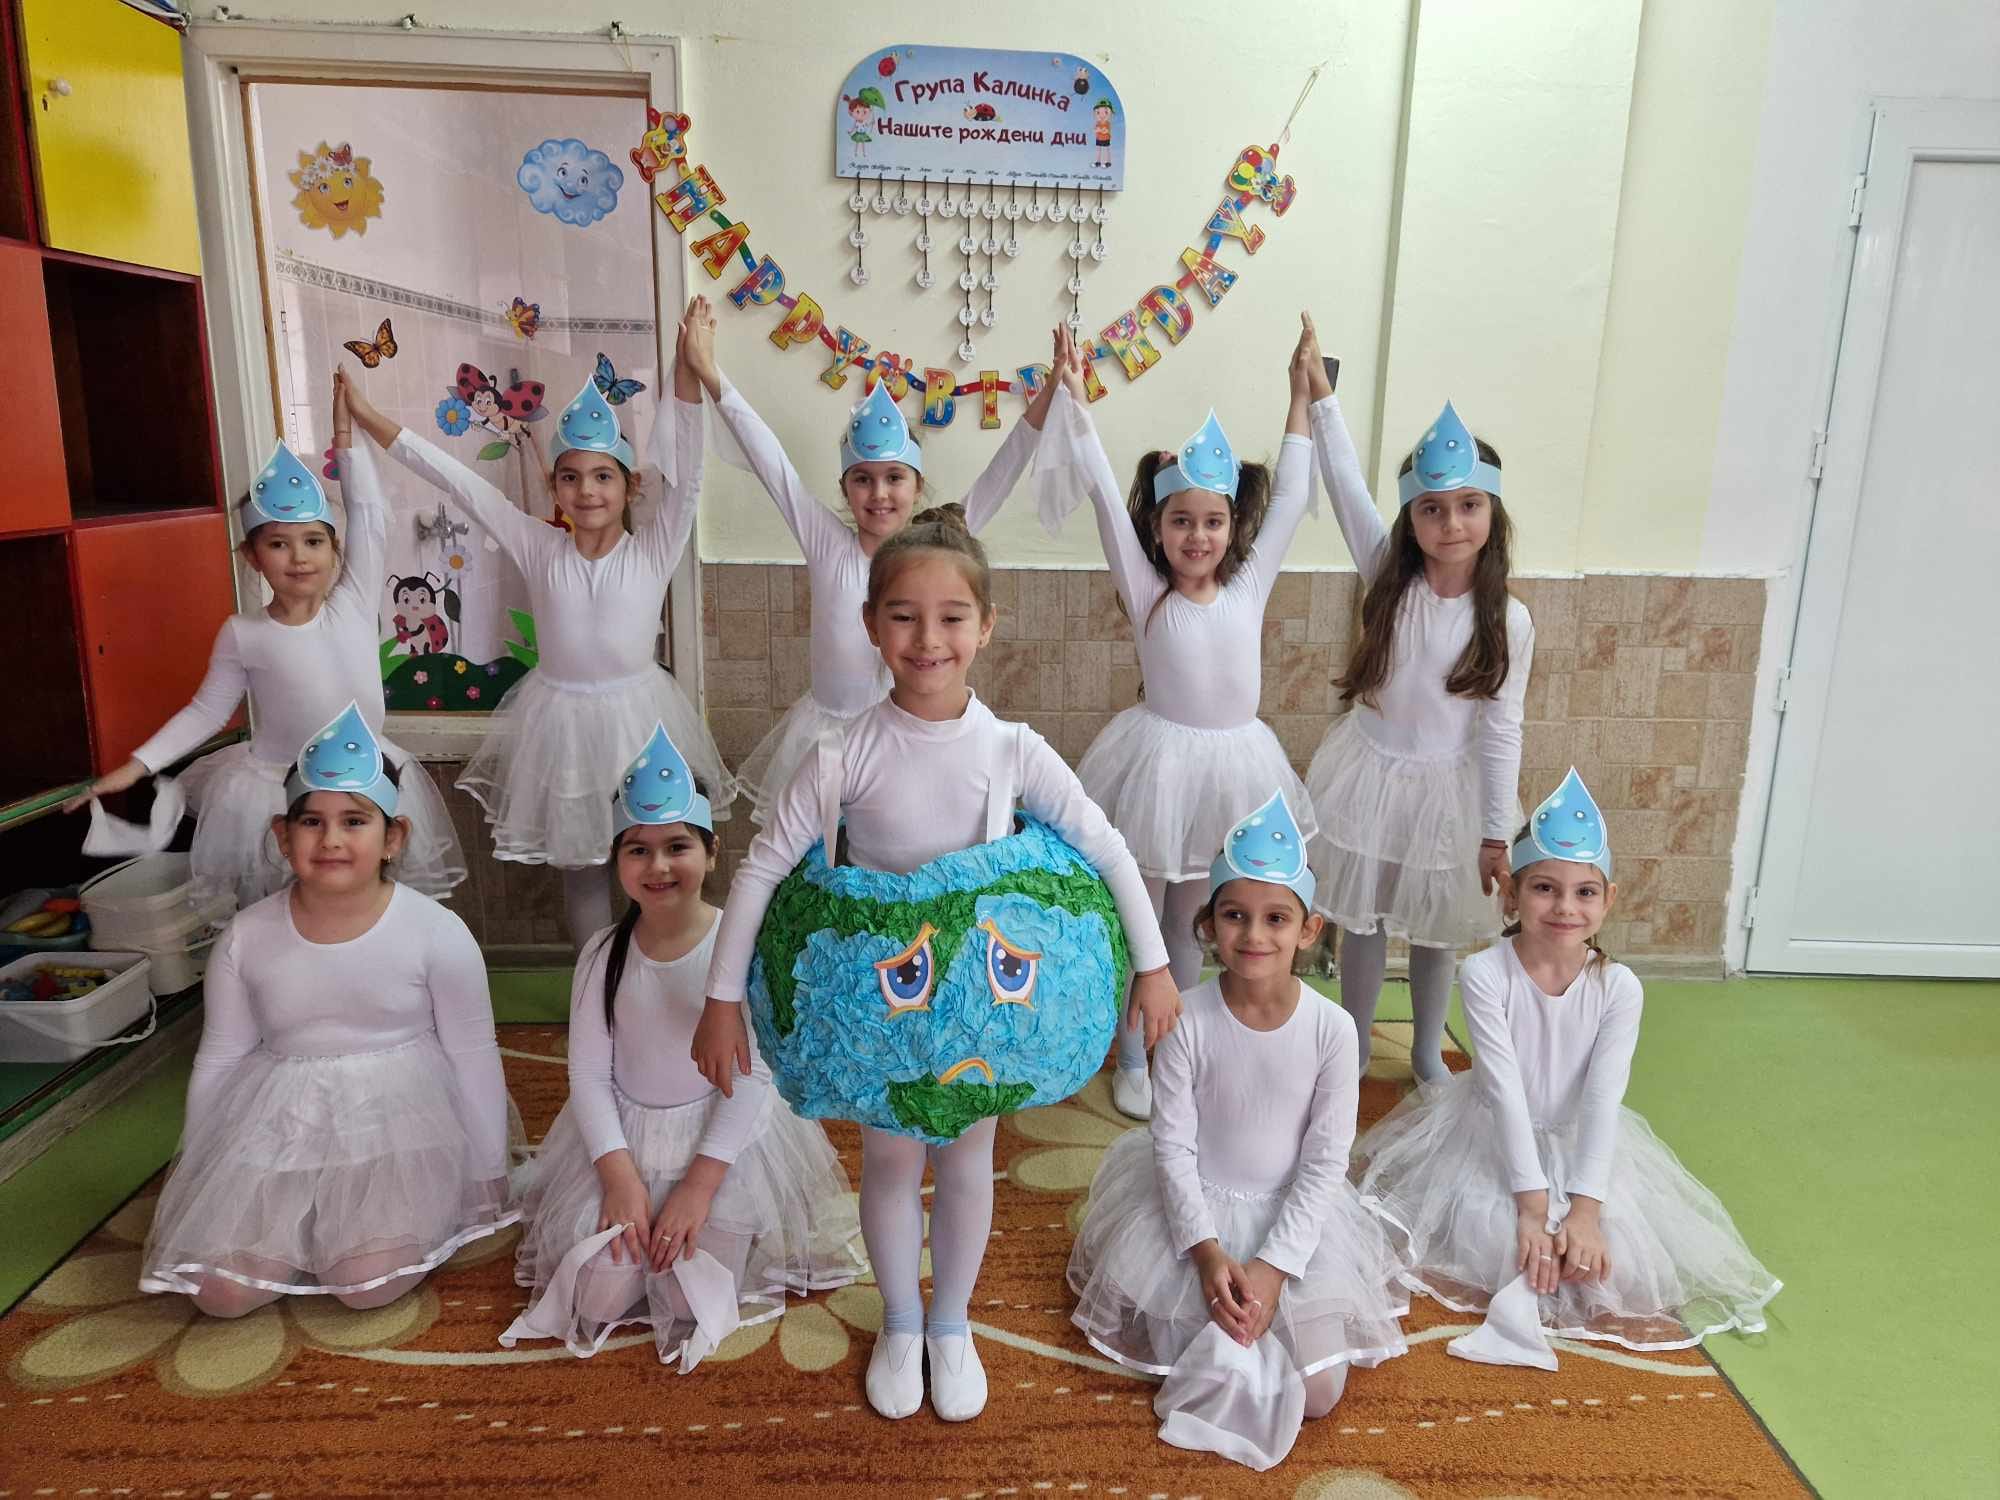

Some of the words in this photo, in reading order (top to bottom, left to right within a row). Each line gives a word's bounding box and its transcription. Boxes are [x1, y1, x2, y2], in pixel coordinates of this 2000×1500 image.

[894, 76, 965, 102] Група
[973, 71, 1071, 112] Калинка
[877, 117, 952, 139] Нашите
[959, 126, 1044, 144] рождени
[1050, 130, 1087, 146] дни
[655, 163, 871, 390] HAPPY
